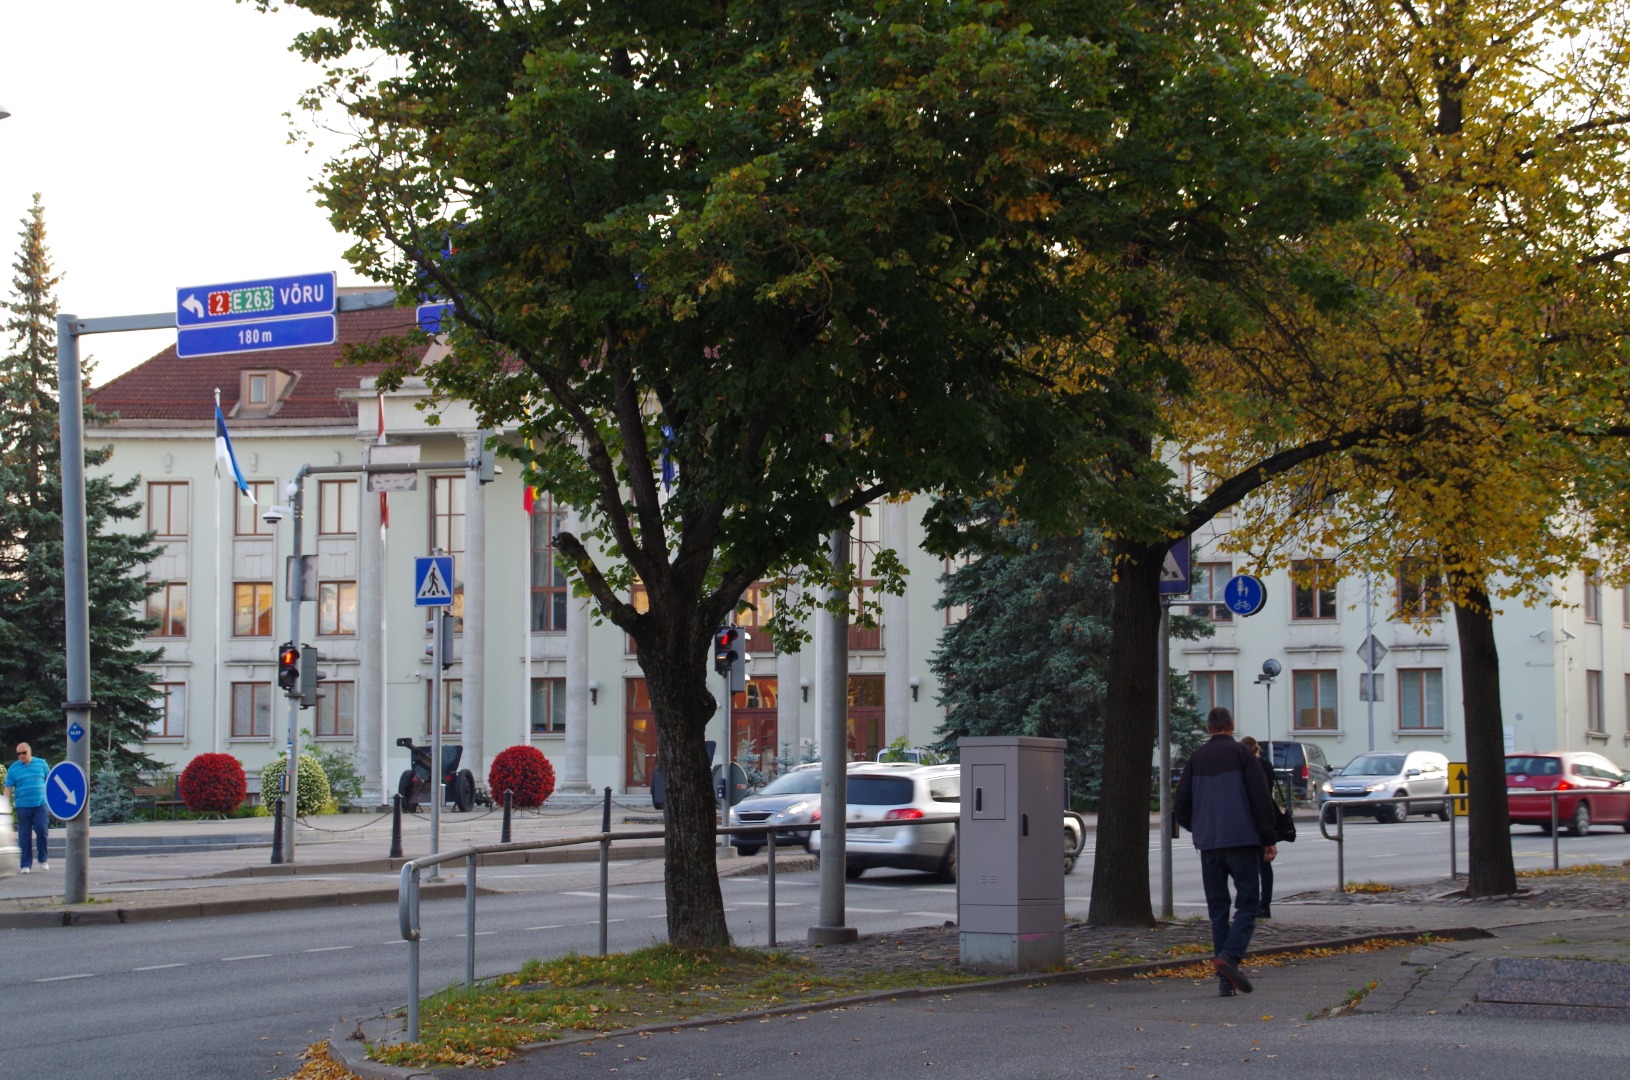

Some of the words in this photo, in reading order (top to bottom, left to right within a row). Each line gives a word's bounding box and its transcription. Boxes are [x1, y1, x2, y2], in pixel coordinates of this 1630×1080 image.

[216, 295, 224, 312] 2
[280, 283, 324, 305] VÕRU
[238, 329, 260, 345] 180
[262, 331, 272, 342] m
